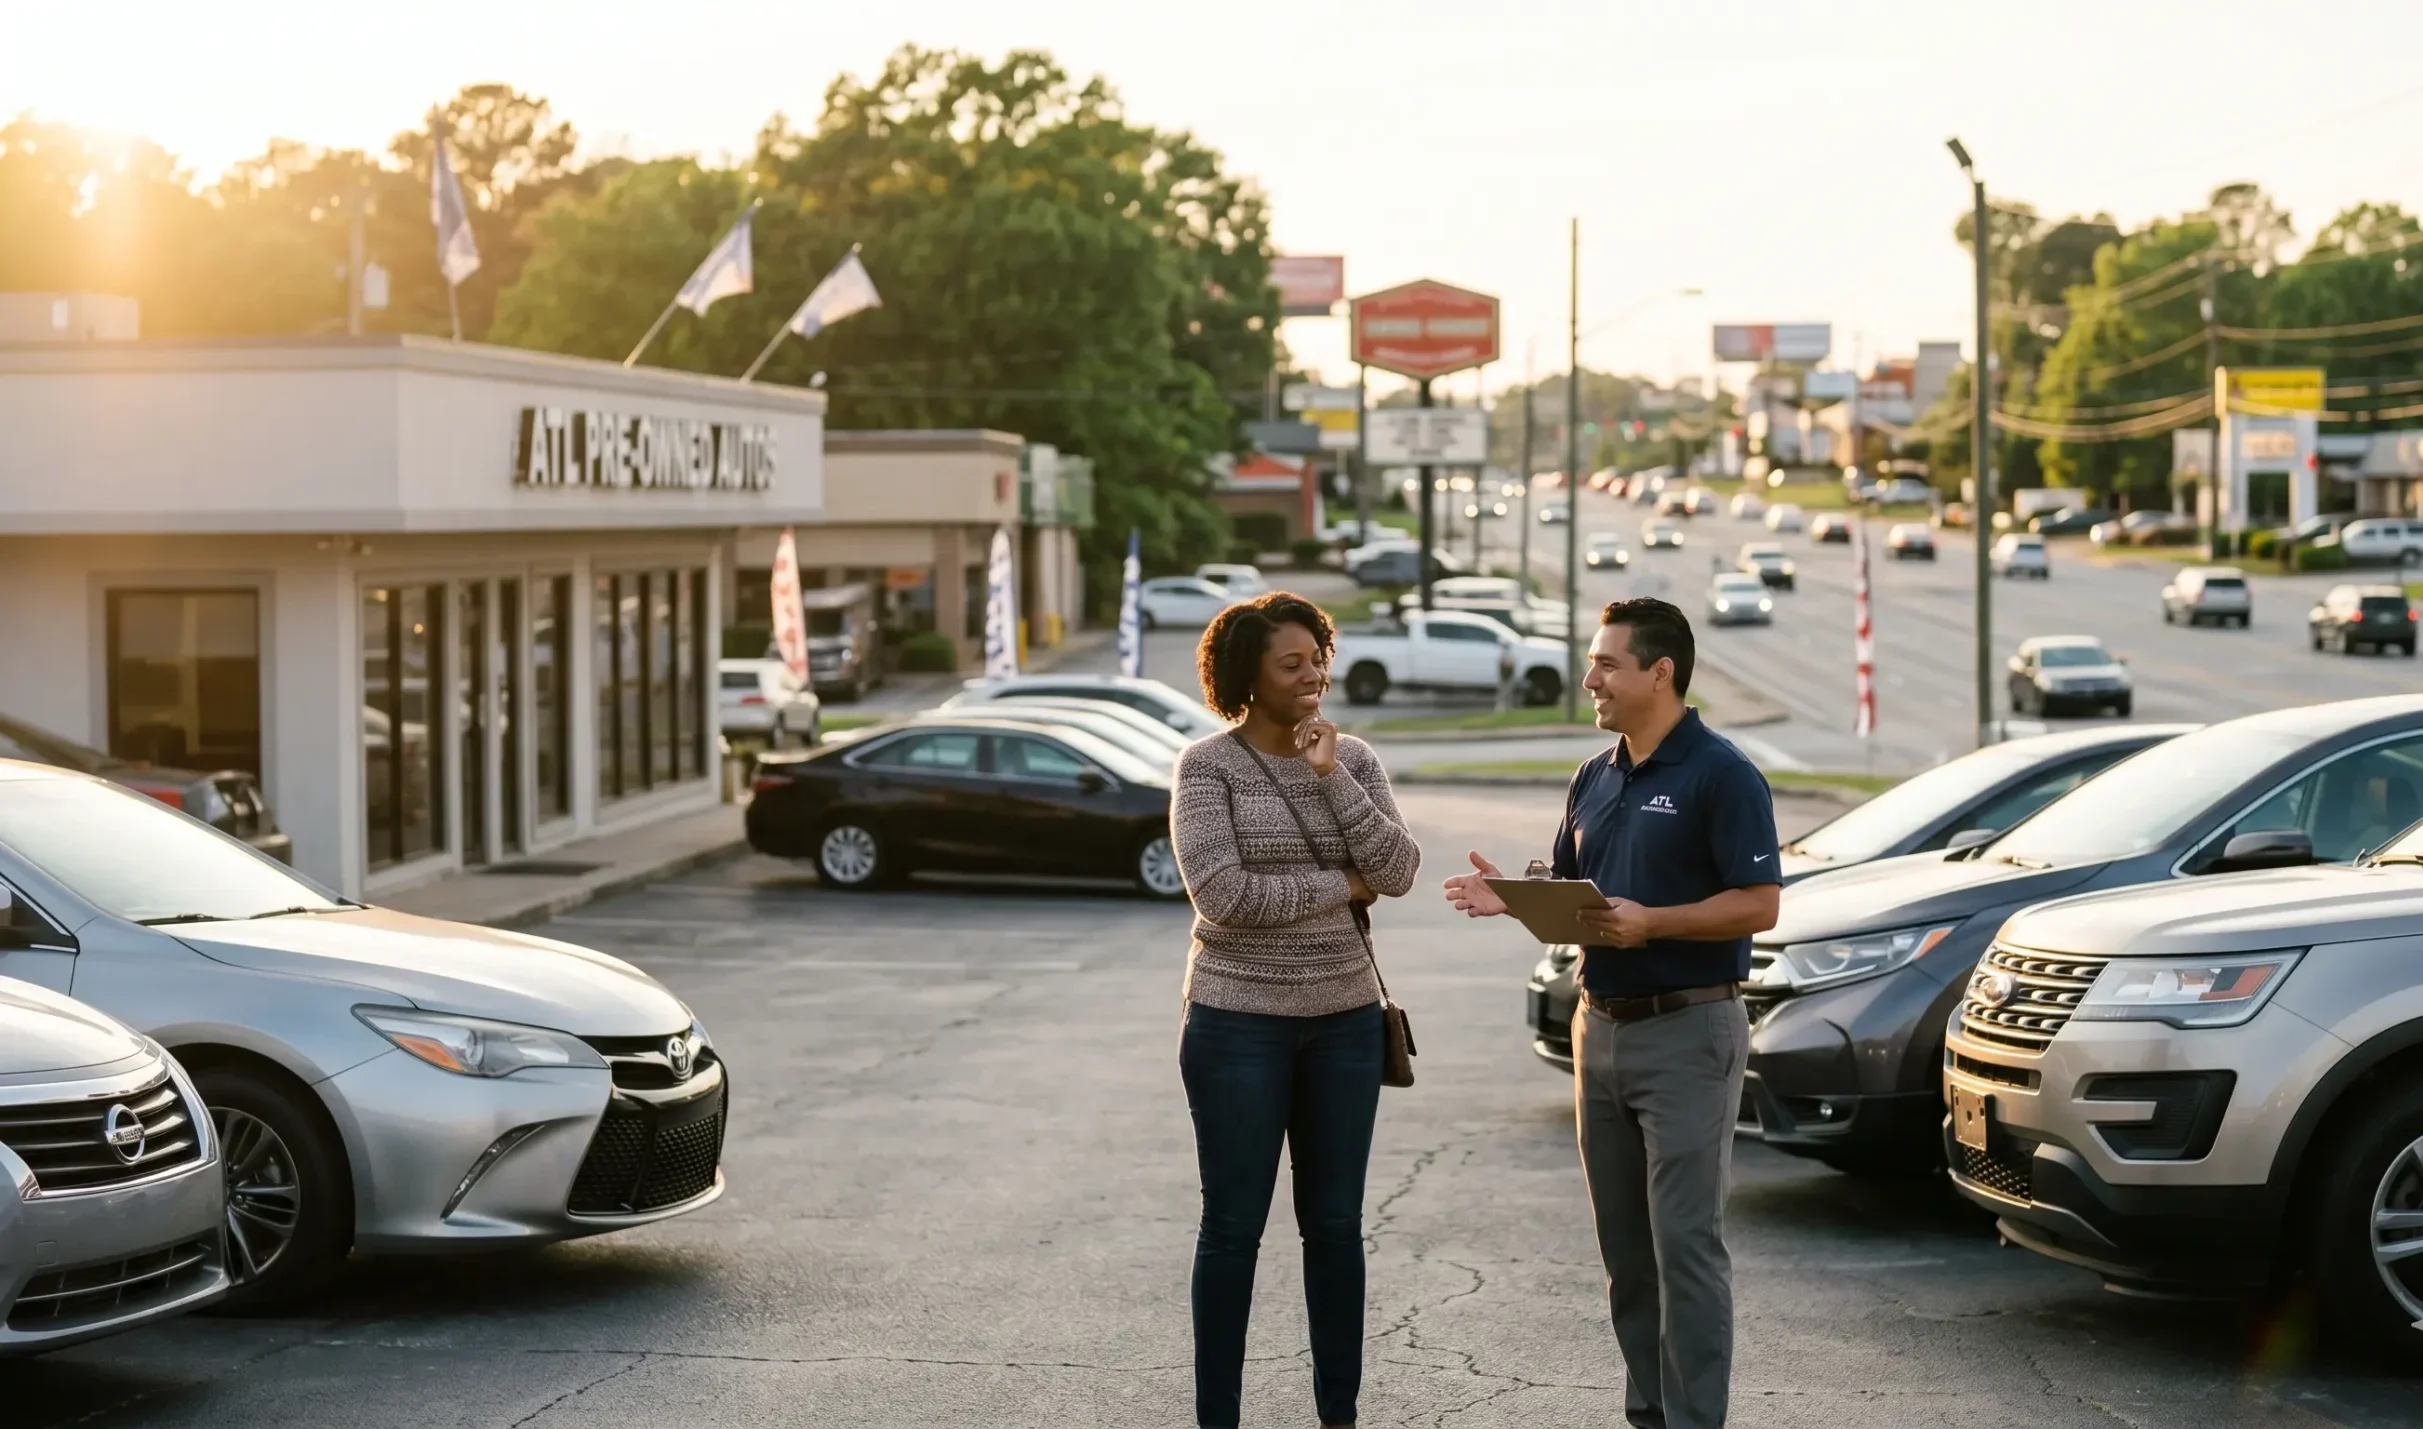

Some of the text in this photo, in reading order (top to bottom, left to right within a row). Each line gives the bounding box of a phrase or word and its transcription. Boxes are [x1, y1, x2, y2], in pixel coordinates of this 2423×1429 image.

[528, 407, 777, 489] ATL PRE-OWNED AUTOS
[1650, 796, 1673, 807] ATL
